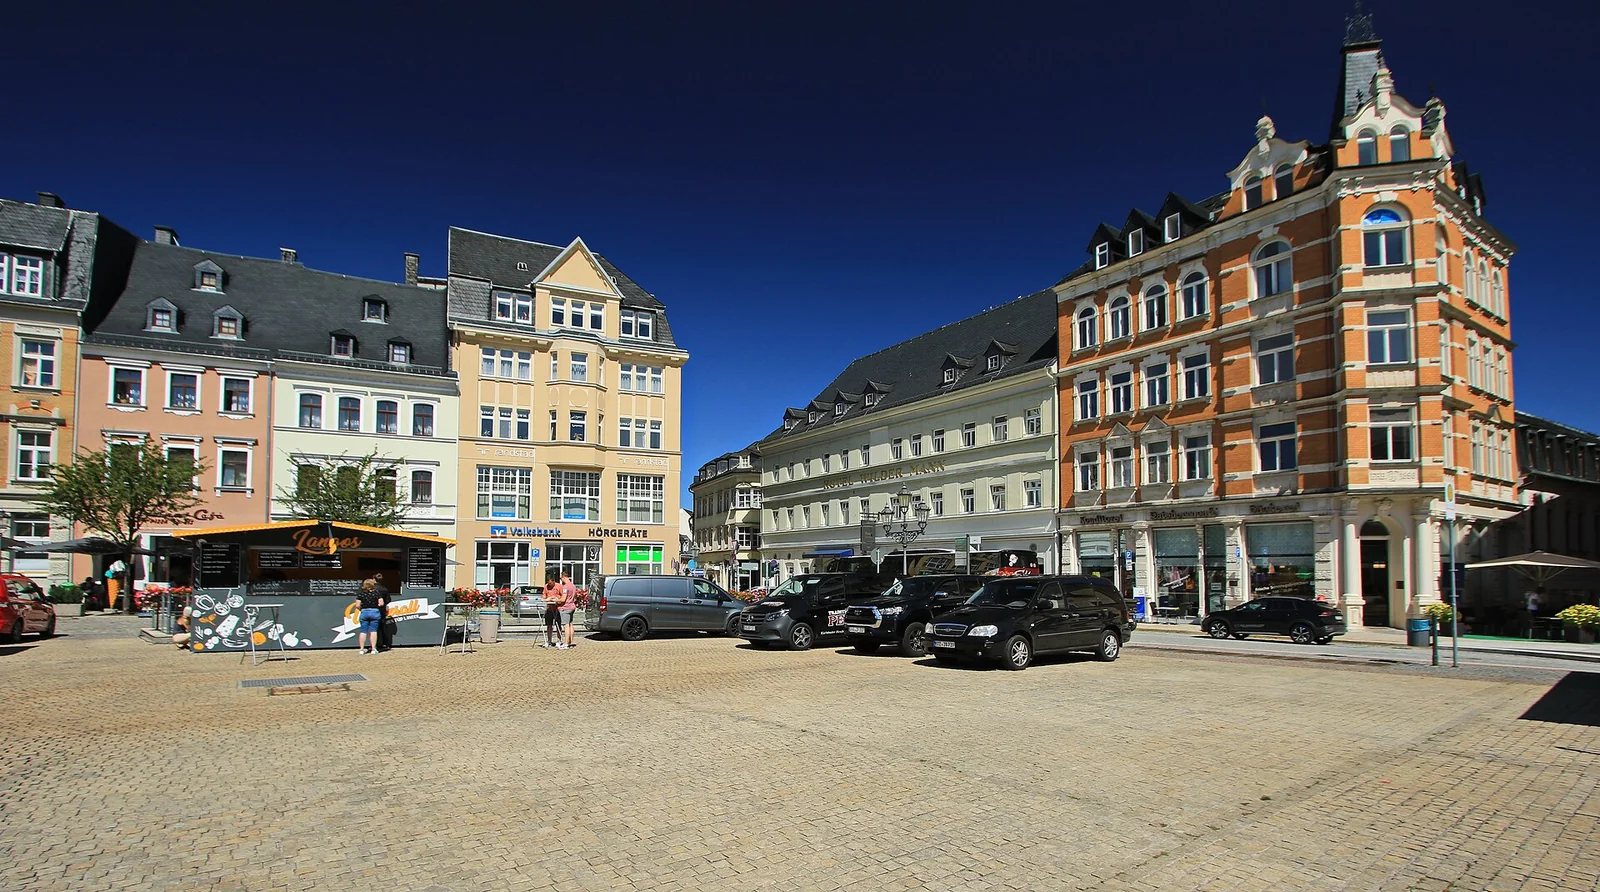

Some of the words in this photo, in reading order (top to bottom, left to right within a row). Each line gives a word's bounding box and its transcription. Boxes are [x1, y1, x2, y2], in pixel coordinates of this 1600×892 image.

[860, 467, 905, 484] WILDER
[910, 459, 947, 477] MANN
[510, 526, 561, 538] Volksbank
[588, 527, 648, 539] HÖRGERÄTE
